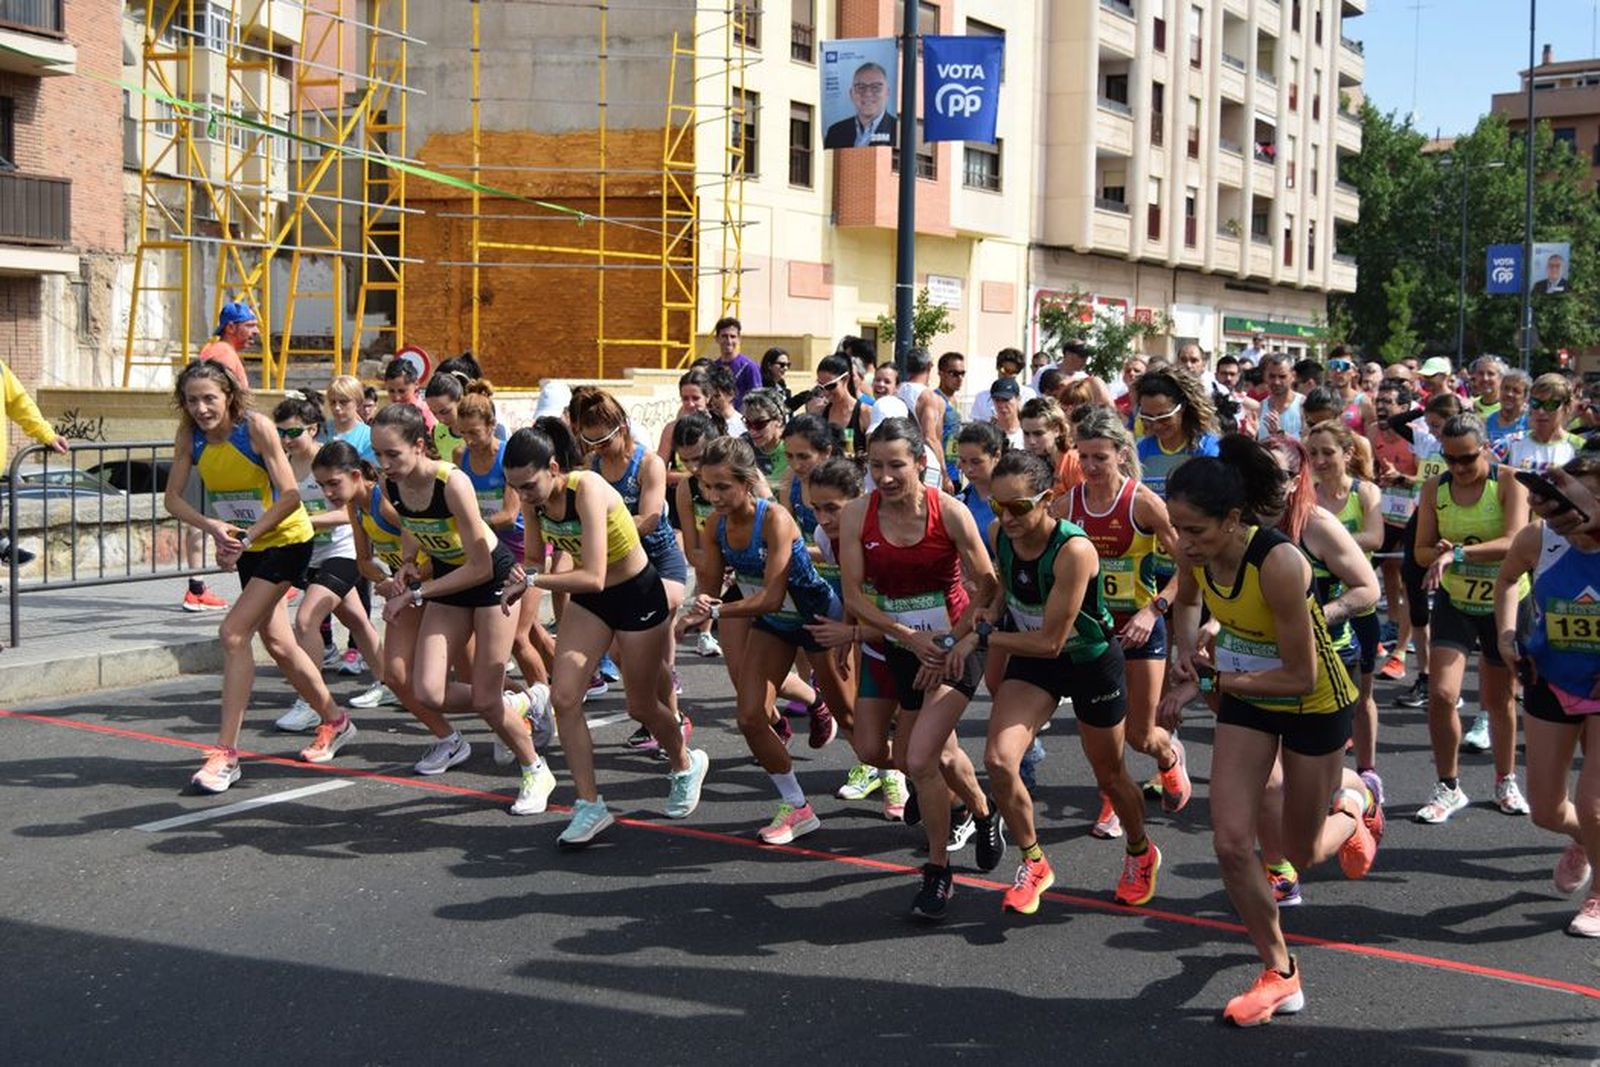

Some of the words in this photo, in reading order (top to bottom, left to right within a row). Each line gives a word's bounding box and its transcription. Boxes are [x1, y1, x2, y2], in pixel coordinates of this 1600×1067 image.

[936, 63, 986, 80] VOTA
[1493, 257, 1515, 266] VOTA
[1424, 463, 1440, 478] 99
[414, 533, 451, 551] 116
[1464, 579, 1494, 601] 72
